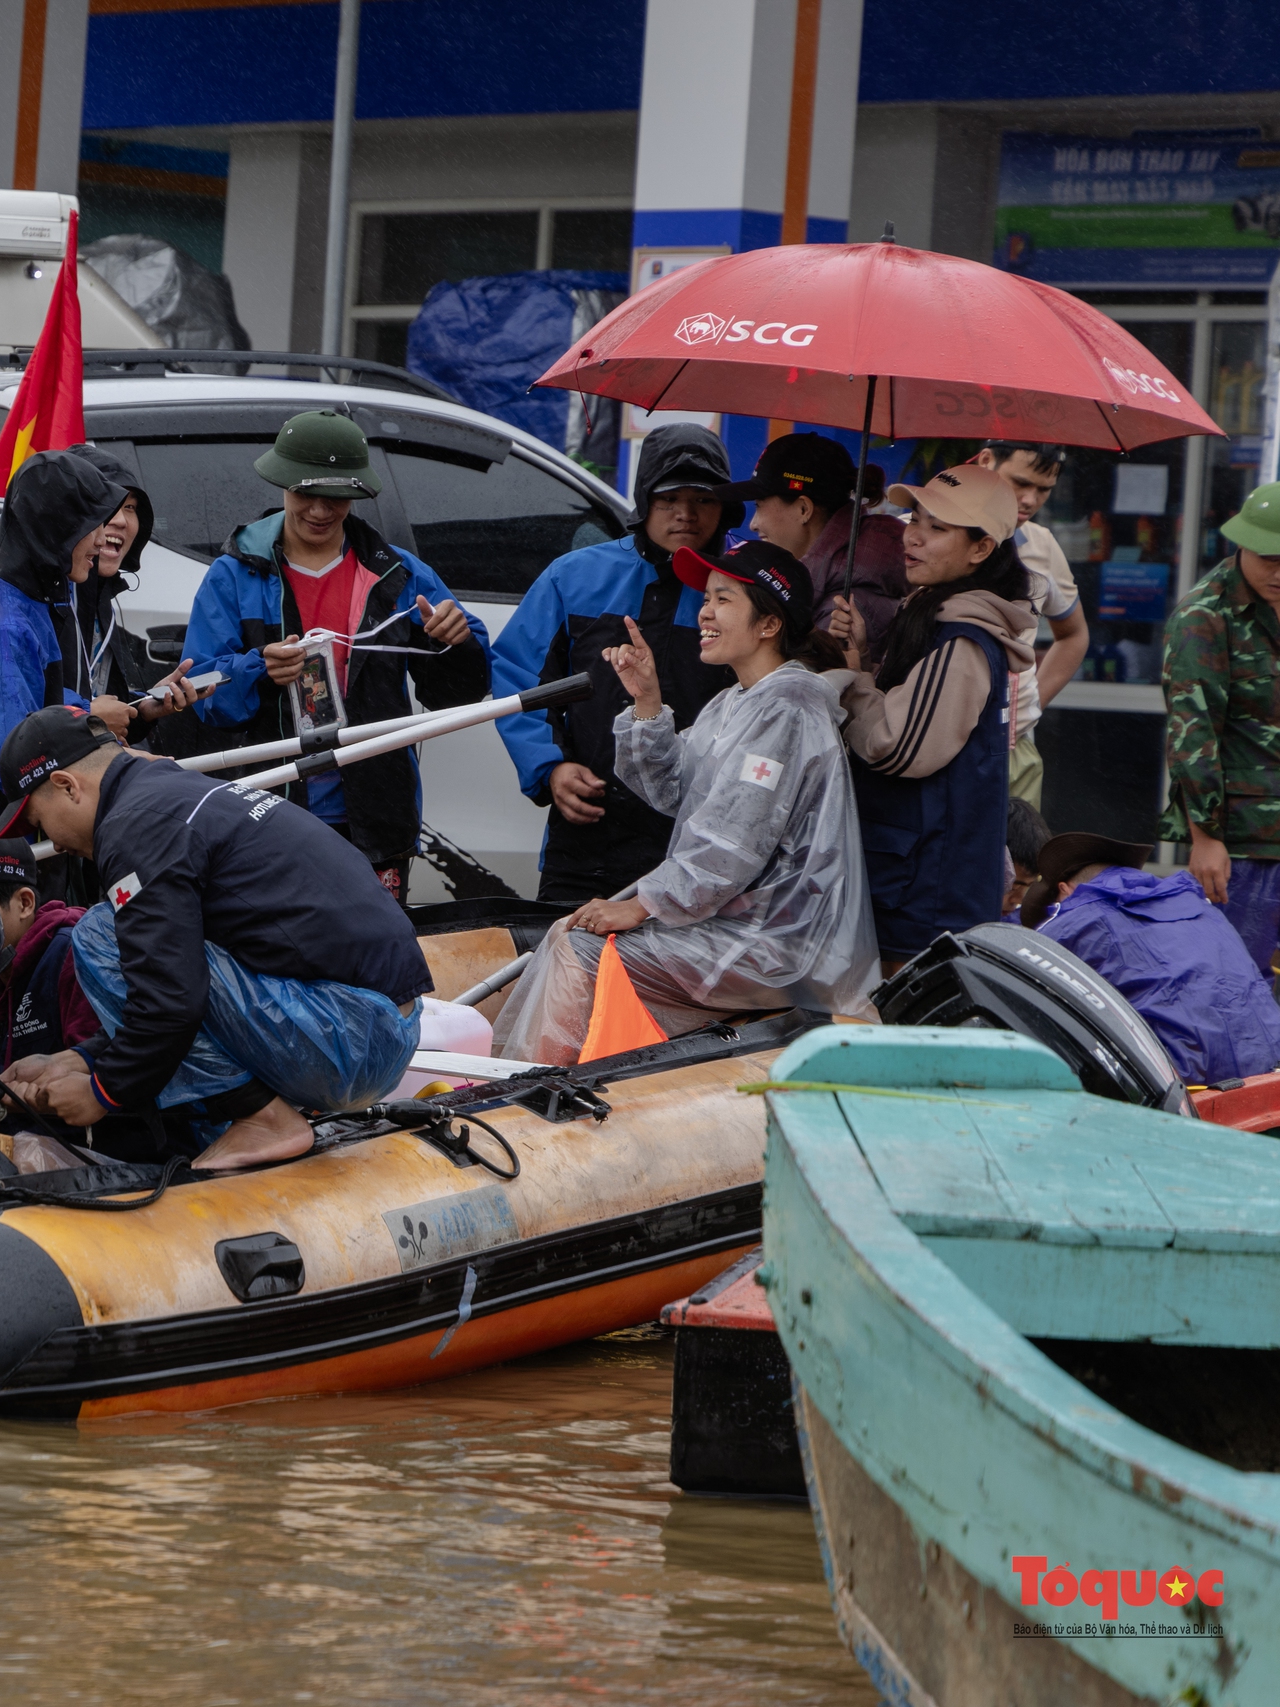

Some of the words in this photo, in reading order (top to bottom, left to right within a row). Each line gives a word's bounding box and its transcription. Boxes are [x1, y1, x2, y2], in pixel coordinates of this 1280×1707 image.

[725, 320, 818, 346] SCG
[1126, 368, 1180, 402] SCG
[769, 566, 791, 589] Hotline
[18, 774, 32, 788] 0772
[32, 766, 44, 778] 423
[45, 759, 58, 771] 434
[19, 755, 46, 775] Hotline
[3, 865, 14, 874] 423
[15, 868, 25, 877] 434
